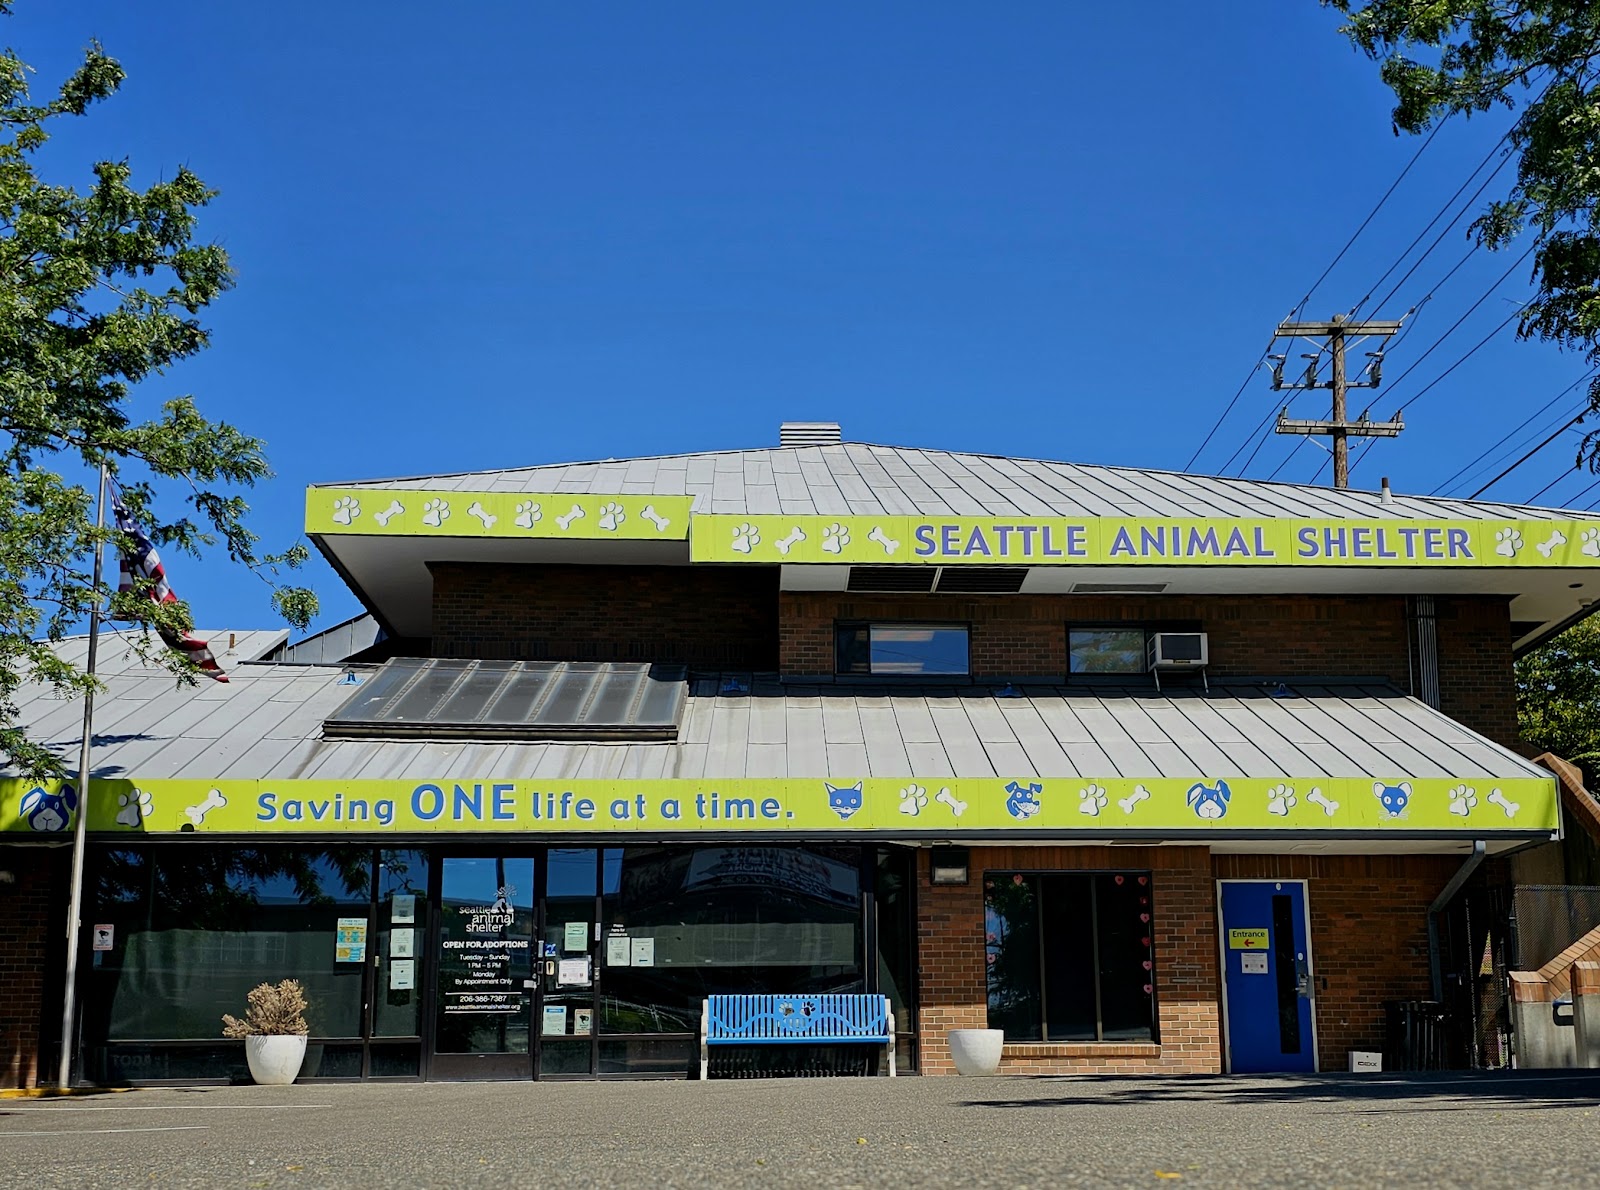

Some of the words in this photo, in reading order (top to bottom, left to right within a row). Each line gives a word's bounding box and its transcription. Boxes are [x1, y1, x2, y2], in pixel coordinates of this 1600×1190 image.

[914, 525, 1087, 557] SEATTLE
[1109, 525, 1275, 558] ANIMAL
[1297, 527, 1475, 559] SHELTER
[256, 793, 395, 825] Saving
[411, 783, 516, 820] ONE
[532, 792, 597, 820] life
[610, 794, 647, 820] at
[660, 798, 682, 820] a
[695, 792, 795, 820] time.
[459, 905, 490, 914] seattle
[472, 912, 514, 926] animal
[465, 921, 503, 932] shelter
[1232, 930, 1266, 938] Entrance
[442, 940, 465, 949] OPEN
[465, 940, 481, 949] FOR
[480, 940, 529, 949] ADOPTIONS
